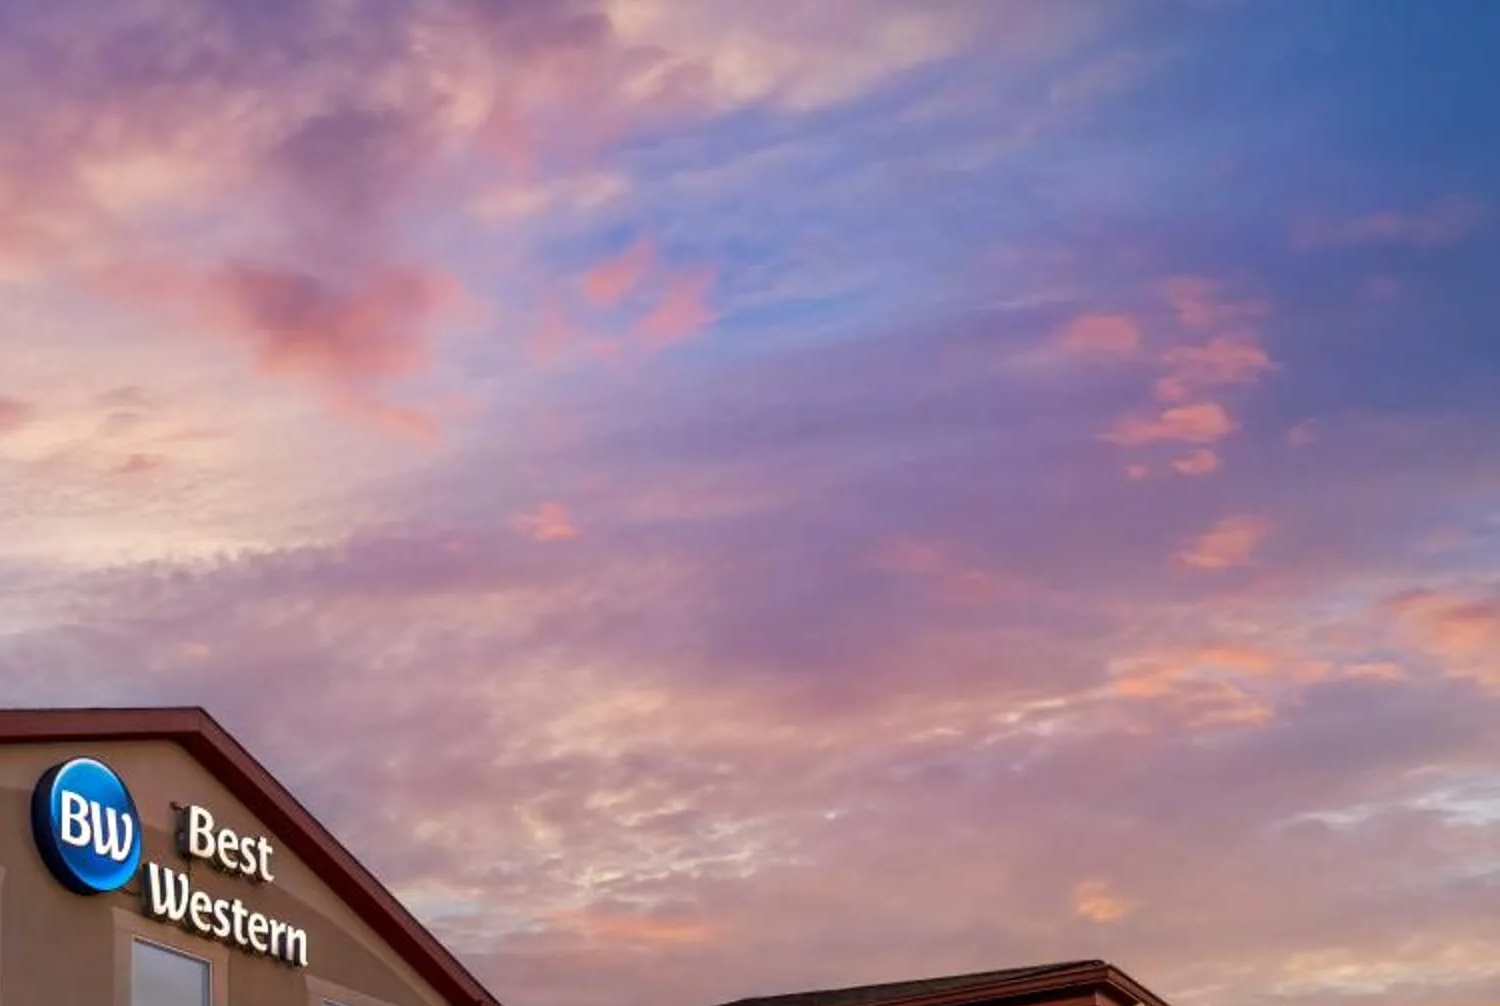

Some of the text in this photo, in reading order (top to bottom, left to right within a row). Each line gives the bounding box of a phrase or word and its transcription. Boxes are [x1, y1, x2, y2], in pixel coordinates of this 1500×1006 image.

[61, 789, 132, 862] BW
[188, 804, 275, 883] Best
[148, 861, 309, 967] Western
